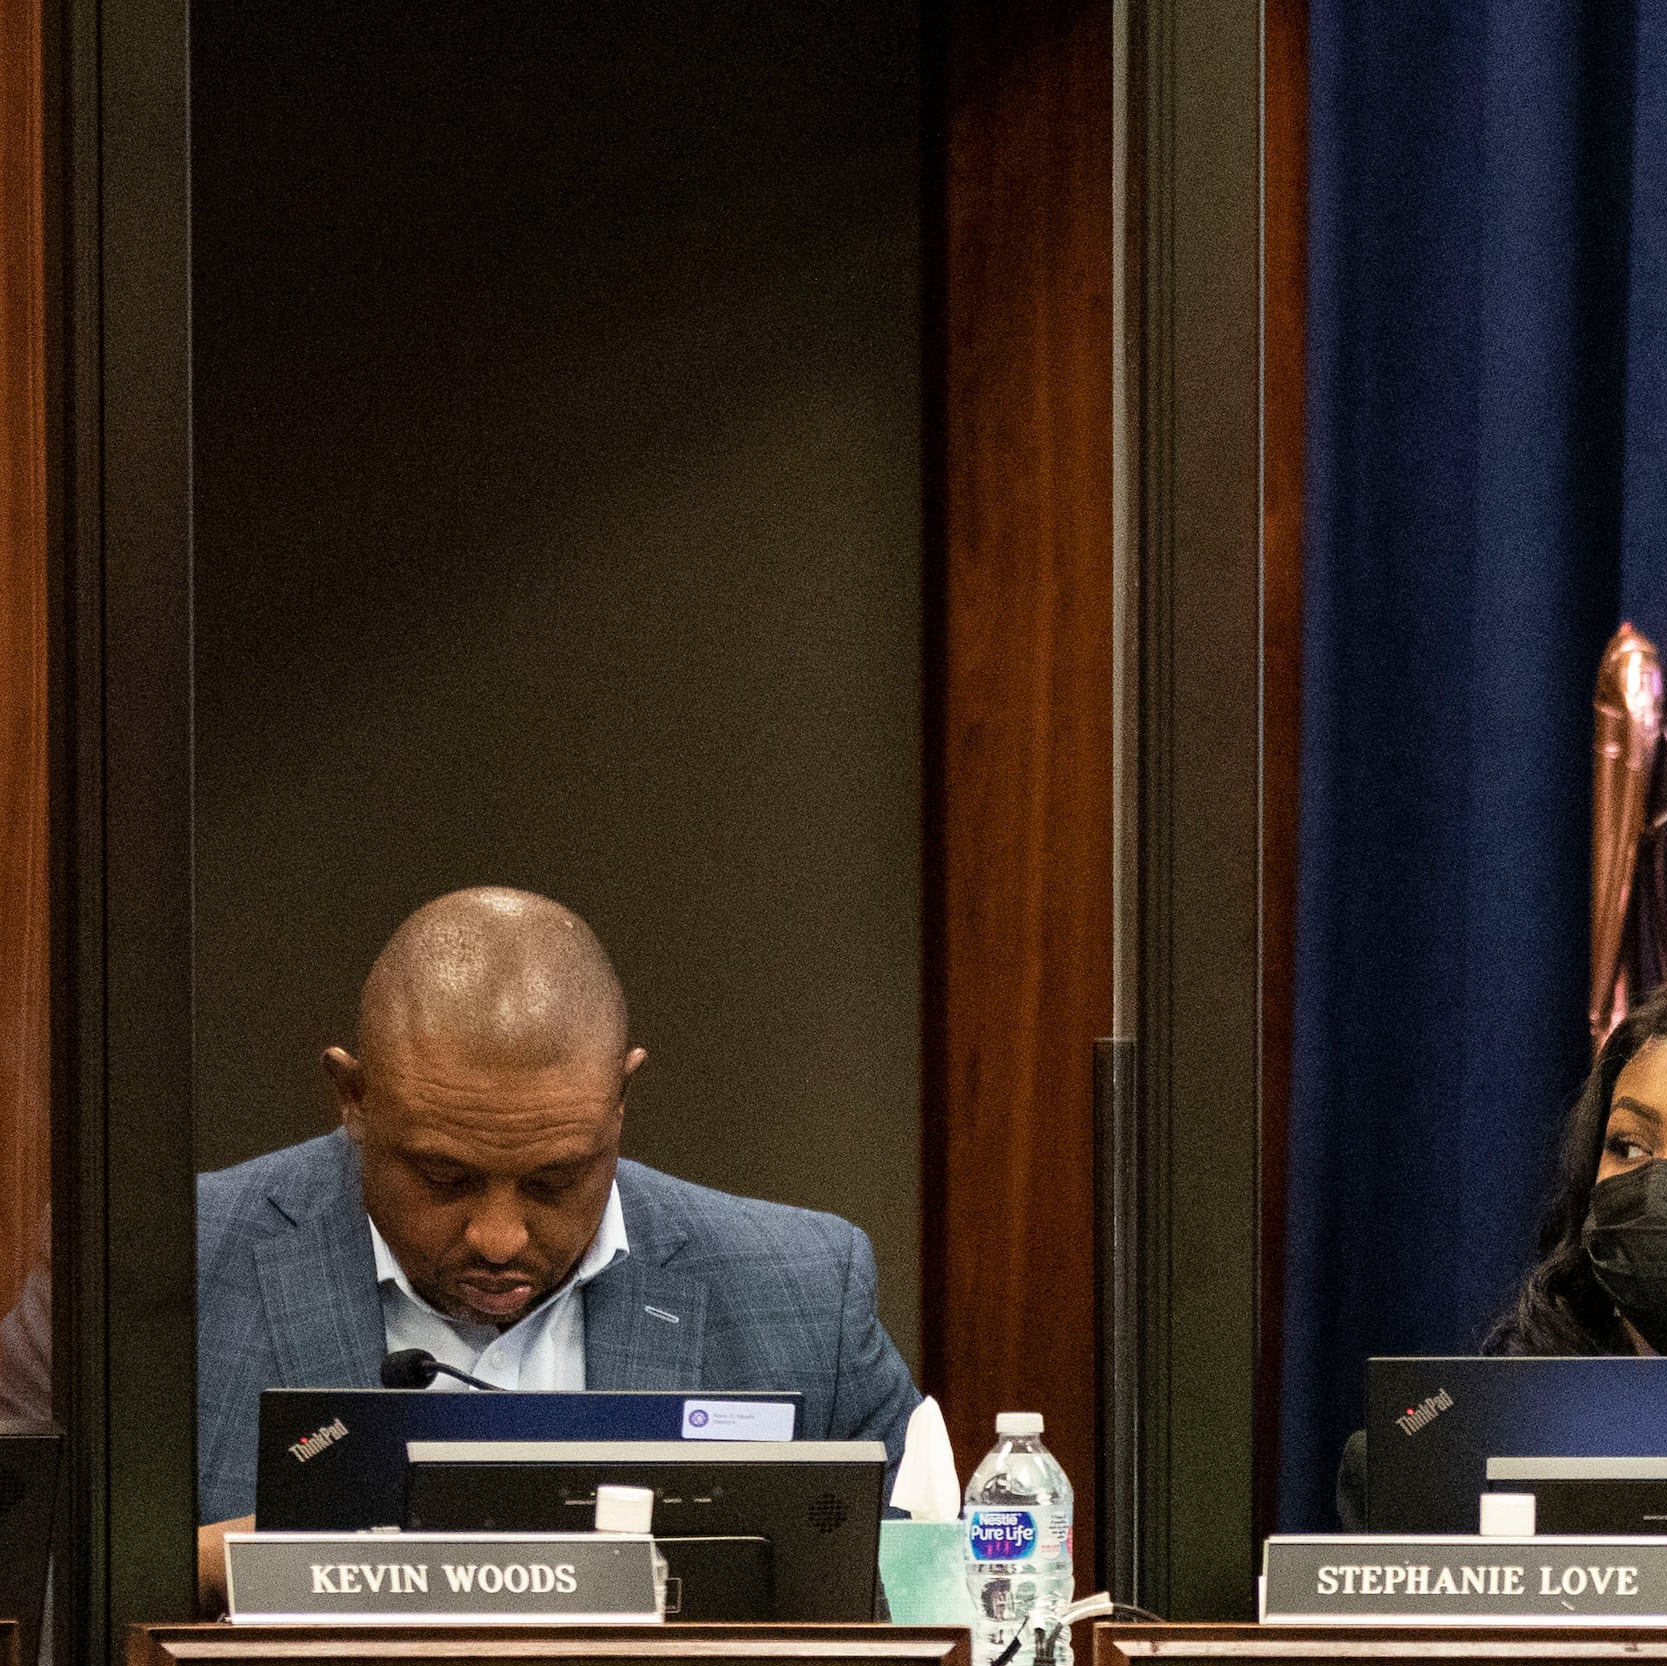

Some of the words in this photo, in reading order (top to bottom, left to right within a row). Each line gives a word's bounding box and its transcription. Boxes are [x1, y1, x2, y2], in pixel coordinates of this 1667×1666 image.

[1395, 1387, 1454, 1437] ThinkPad
[288, 1417, 349, 1463] ThinkPad
[971, 1525, 1005, 1541] Pure
[1006, 1525, 1034, 1547] Life
[310, 1563, 428, 1595] KEVIN
[442, 1563, 578, 1595] WOODS
[1316, 1565, 1525, 1597] STEPHANIE
[1539, 1565, 1639, 1597] LOVE
